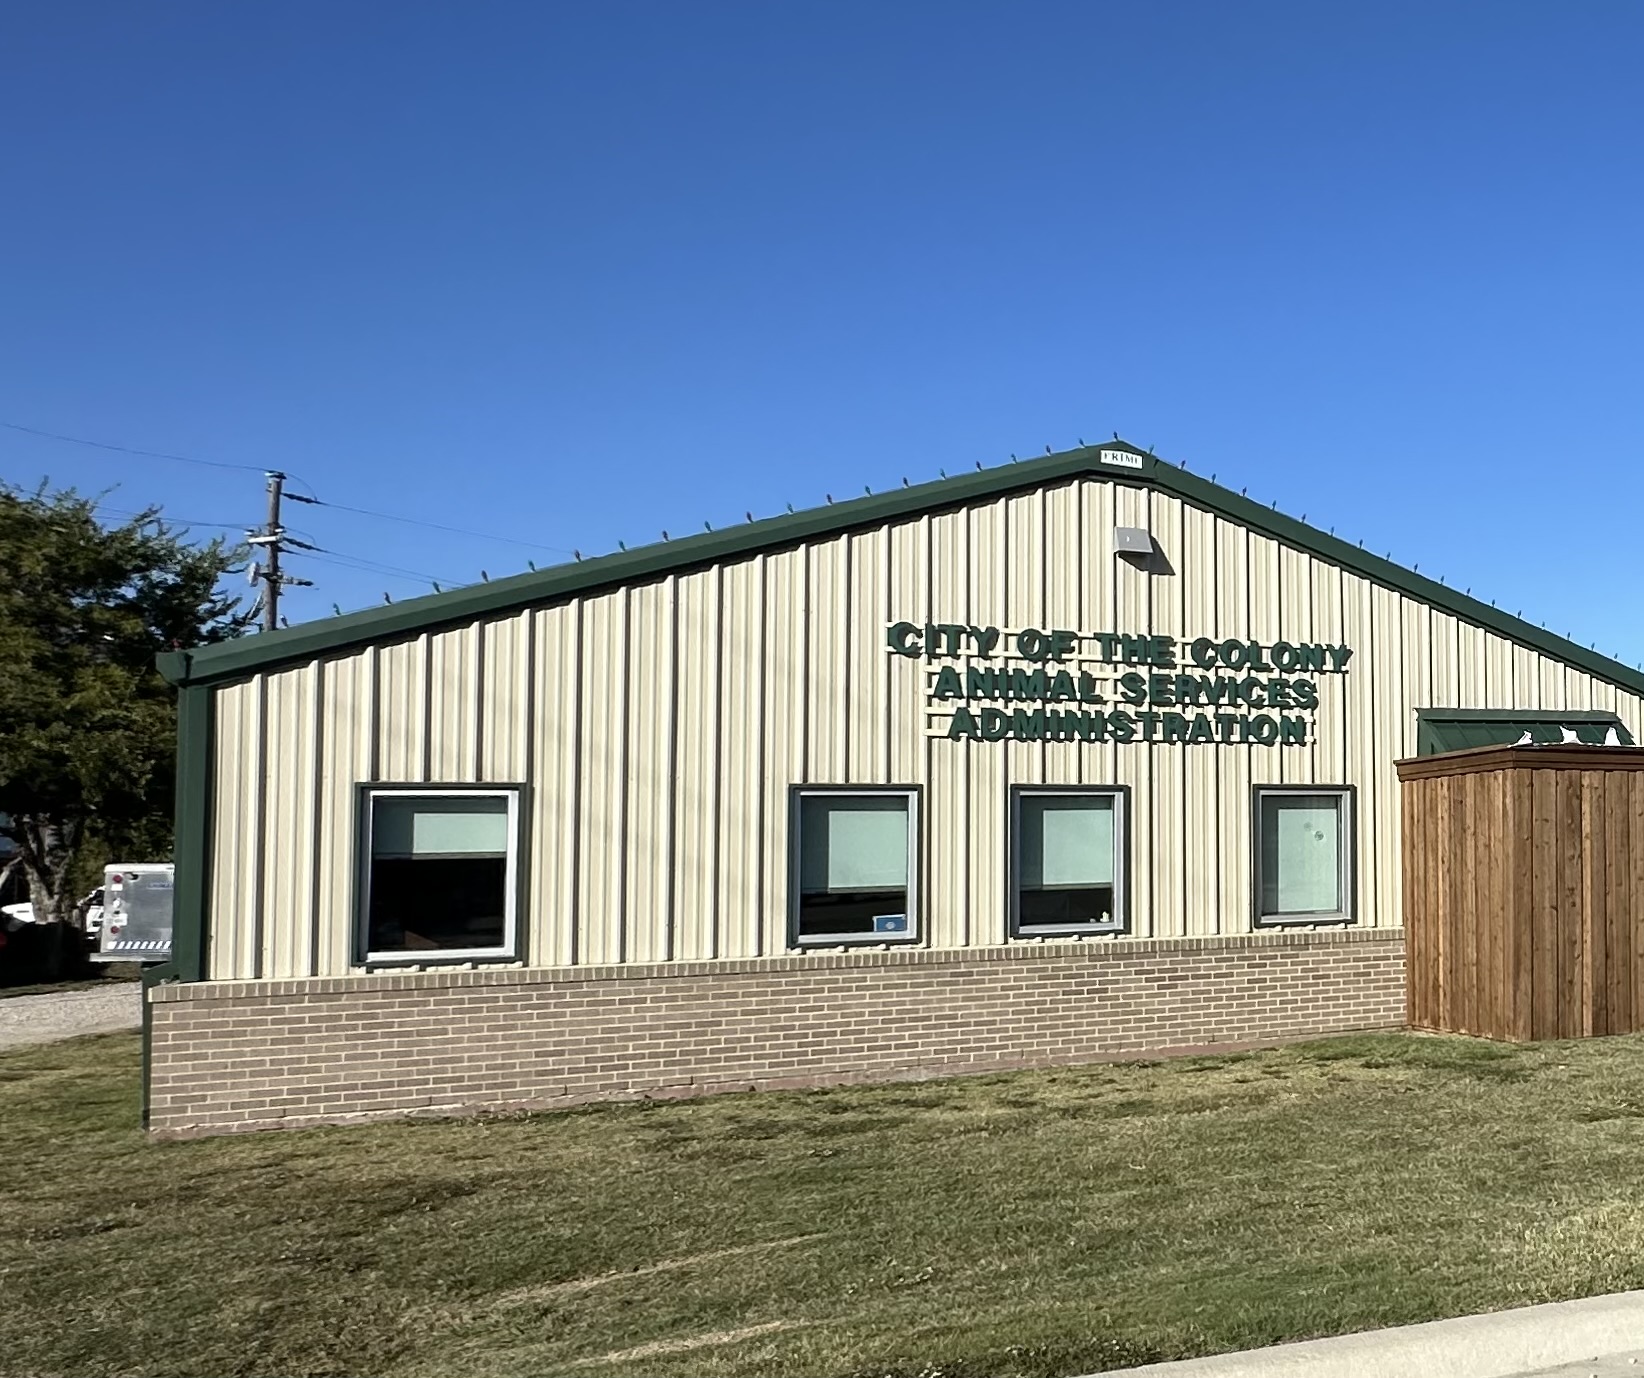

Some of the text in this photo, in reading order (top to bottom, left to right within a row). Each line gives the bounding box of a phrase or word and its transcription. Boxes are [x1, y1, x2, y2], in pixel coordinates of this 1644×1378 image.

[888, 622, 1353, 674] CITY OF THE COLONY
[933, 666, 1319, 711] ANIMAL SERVICES
[949, 706, 1307, 746] ADMINISTRATION
